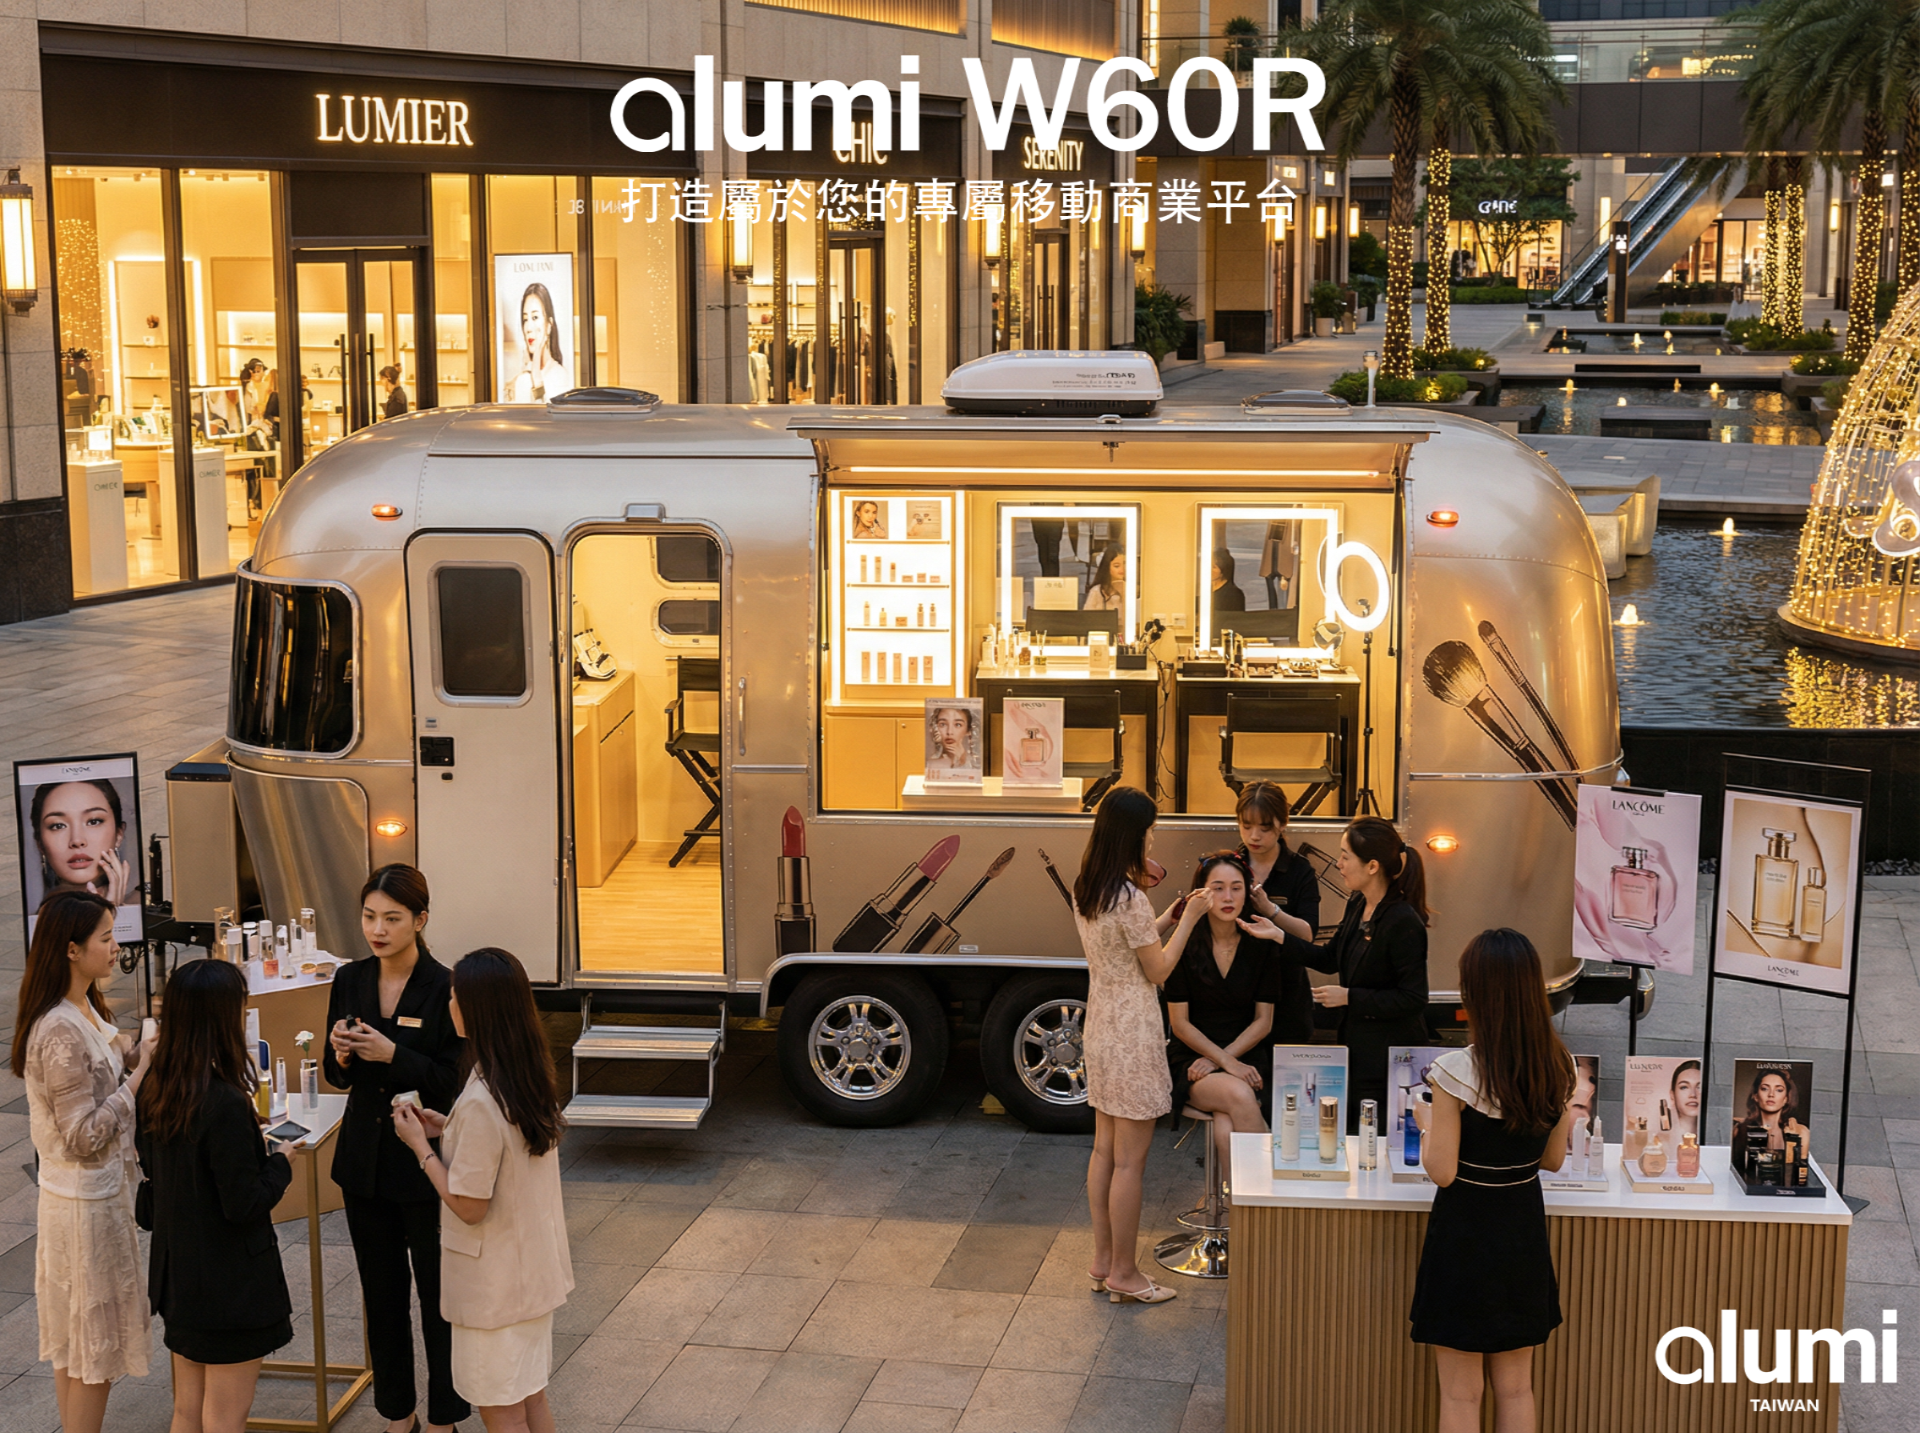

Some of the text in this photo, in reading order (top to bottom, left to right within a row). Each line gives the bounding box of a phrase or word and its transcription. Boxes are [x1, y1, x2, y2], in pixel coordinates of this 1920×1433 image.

[315, 93, 474, 146] LUMIER
[1023, 136, 1084, 171] SERENITY
[1612, 800, 1665, 814] LANCÔME
